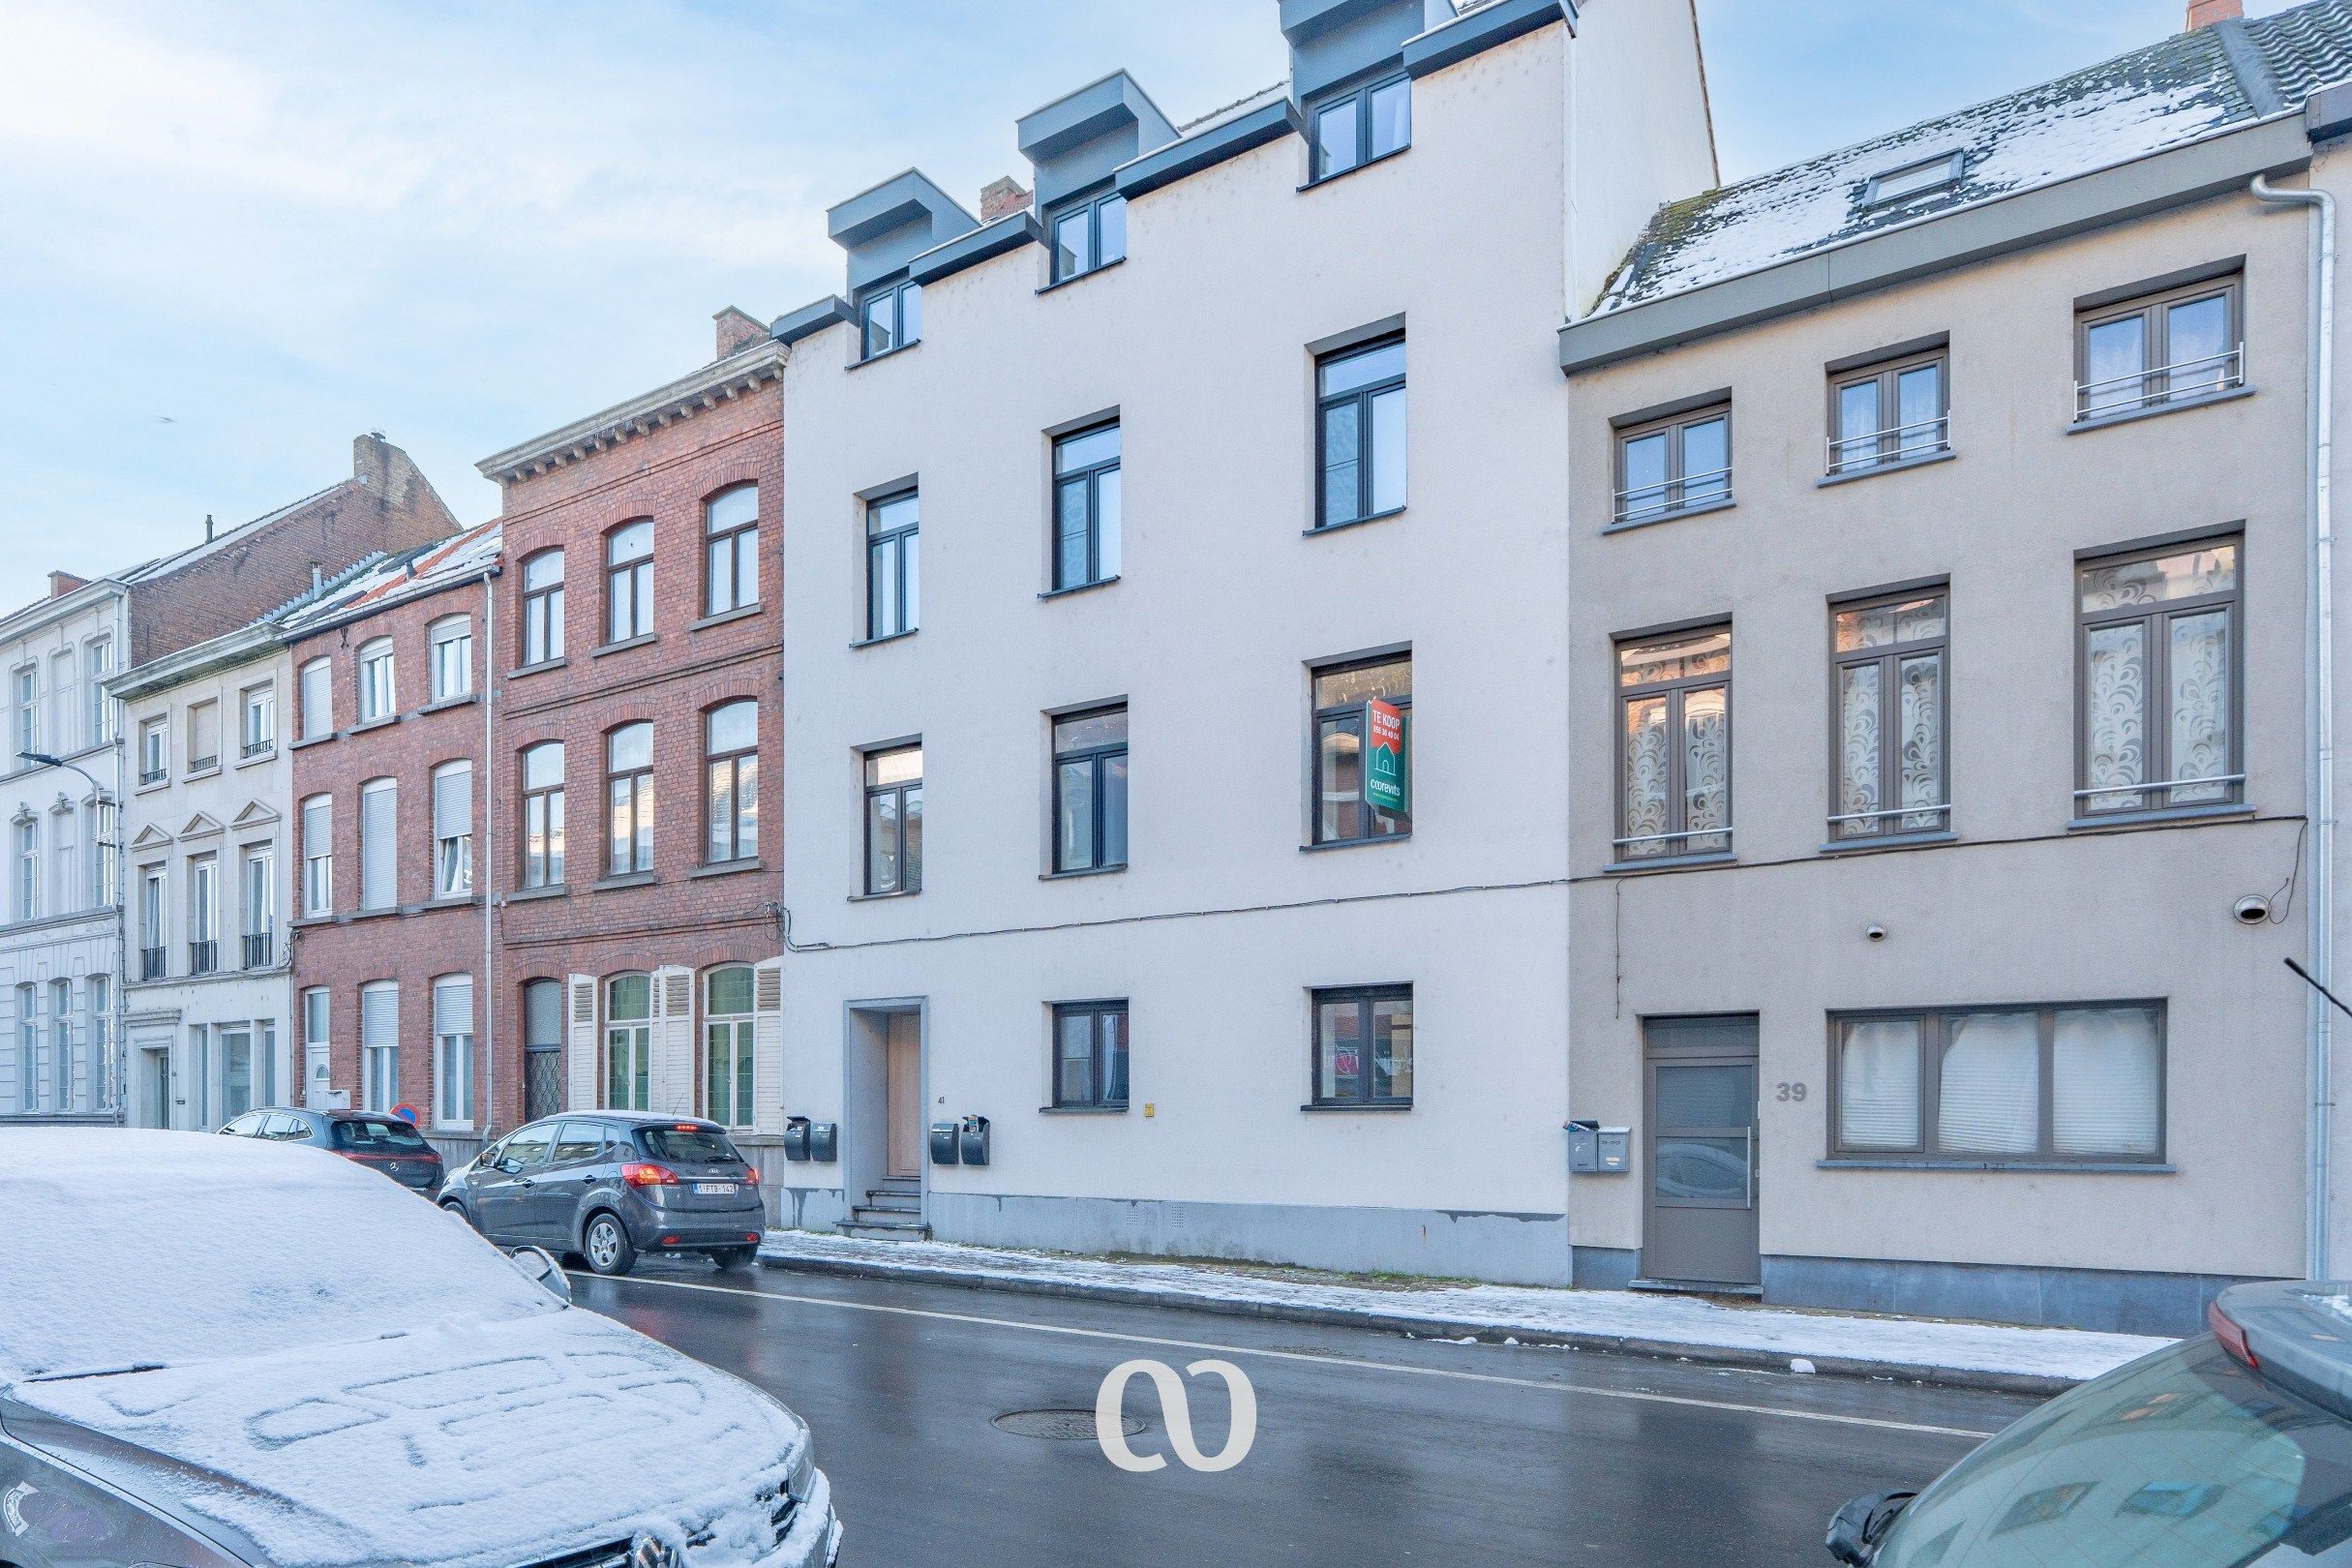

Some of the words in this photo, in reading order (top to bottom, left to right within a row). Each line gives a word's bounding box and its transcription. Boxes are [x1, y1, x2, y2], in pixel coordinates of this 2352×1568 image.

[1372, 709, 1381, 724] TE
[1382, 713, 1401, 730] KOOP
[937, 1096, 945, 1104] 41
[1776, 1082, 1807, 1101] 39
